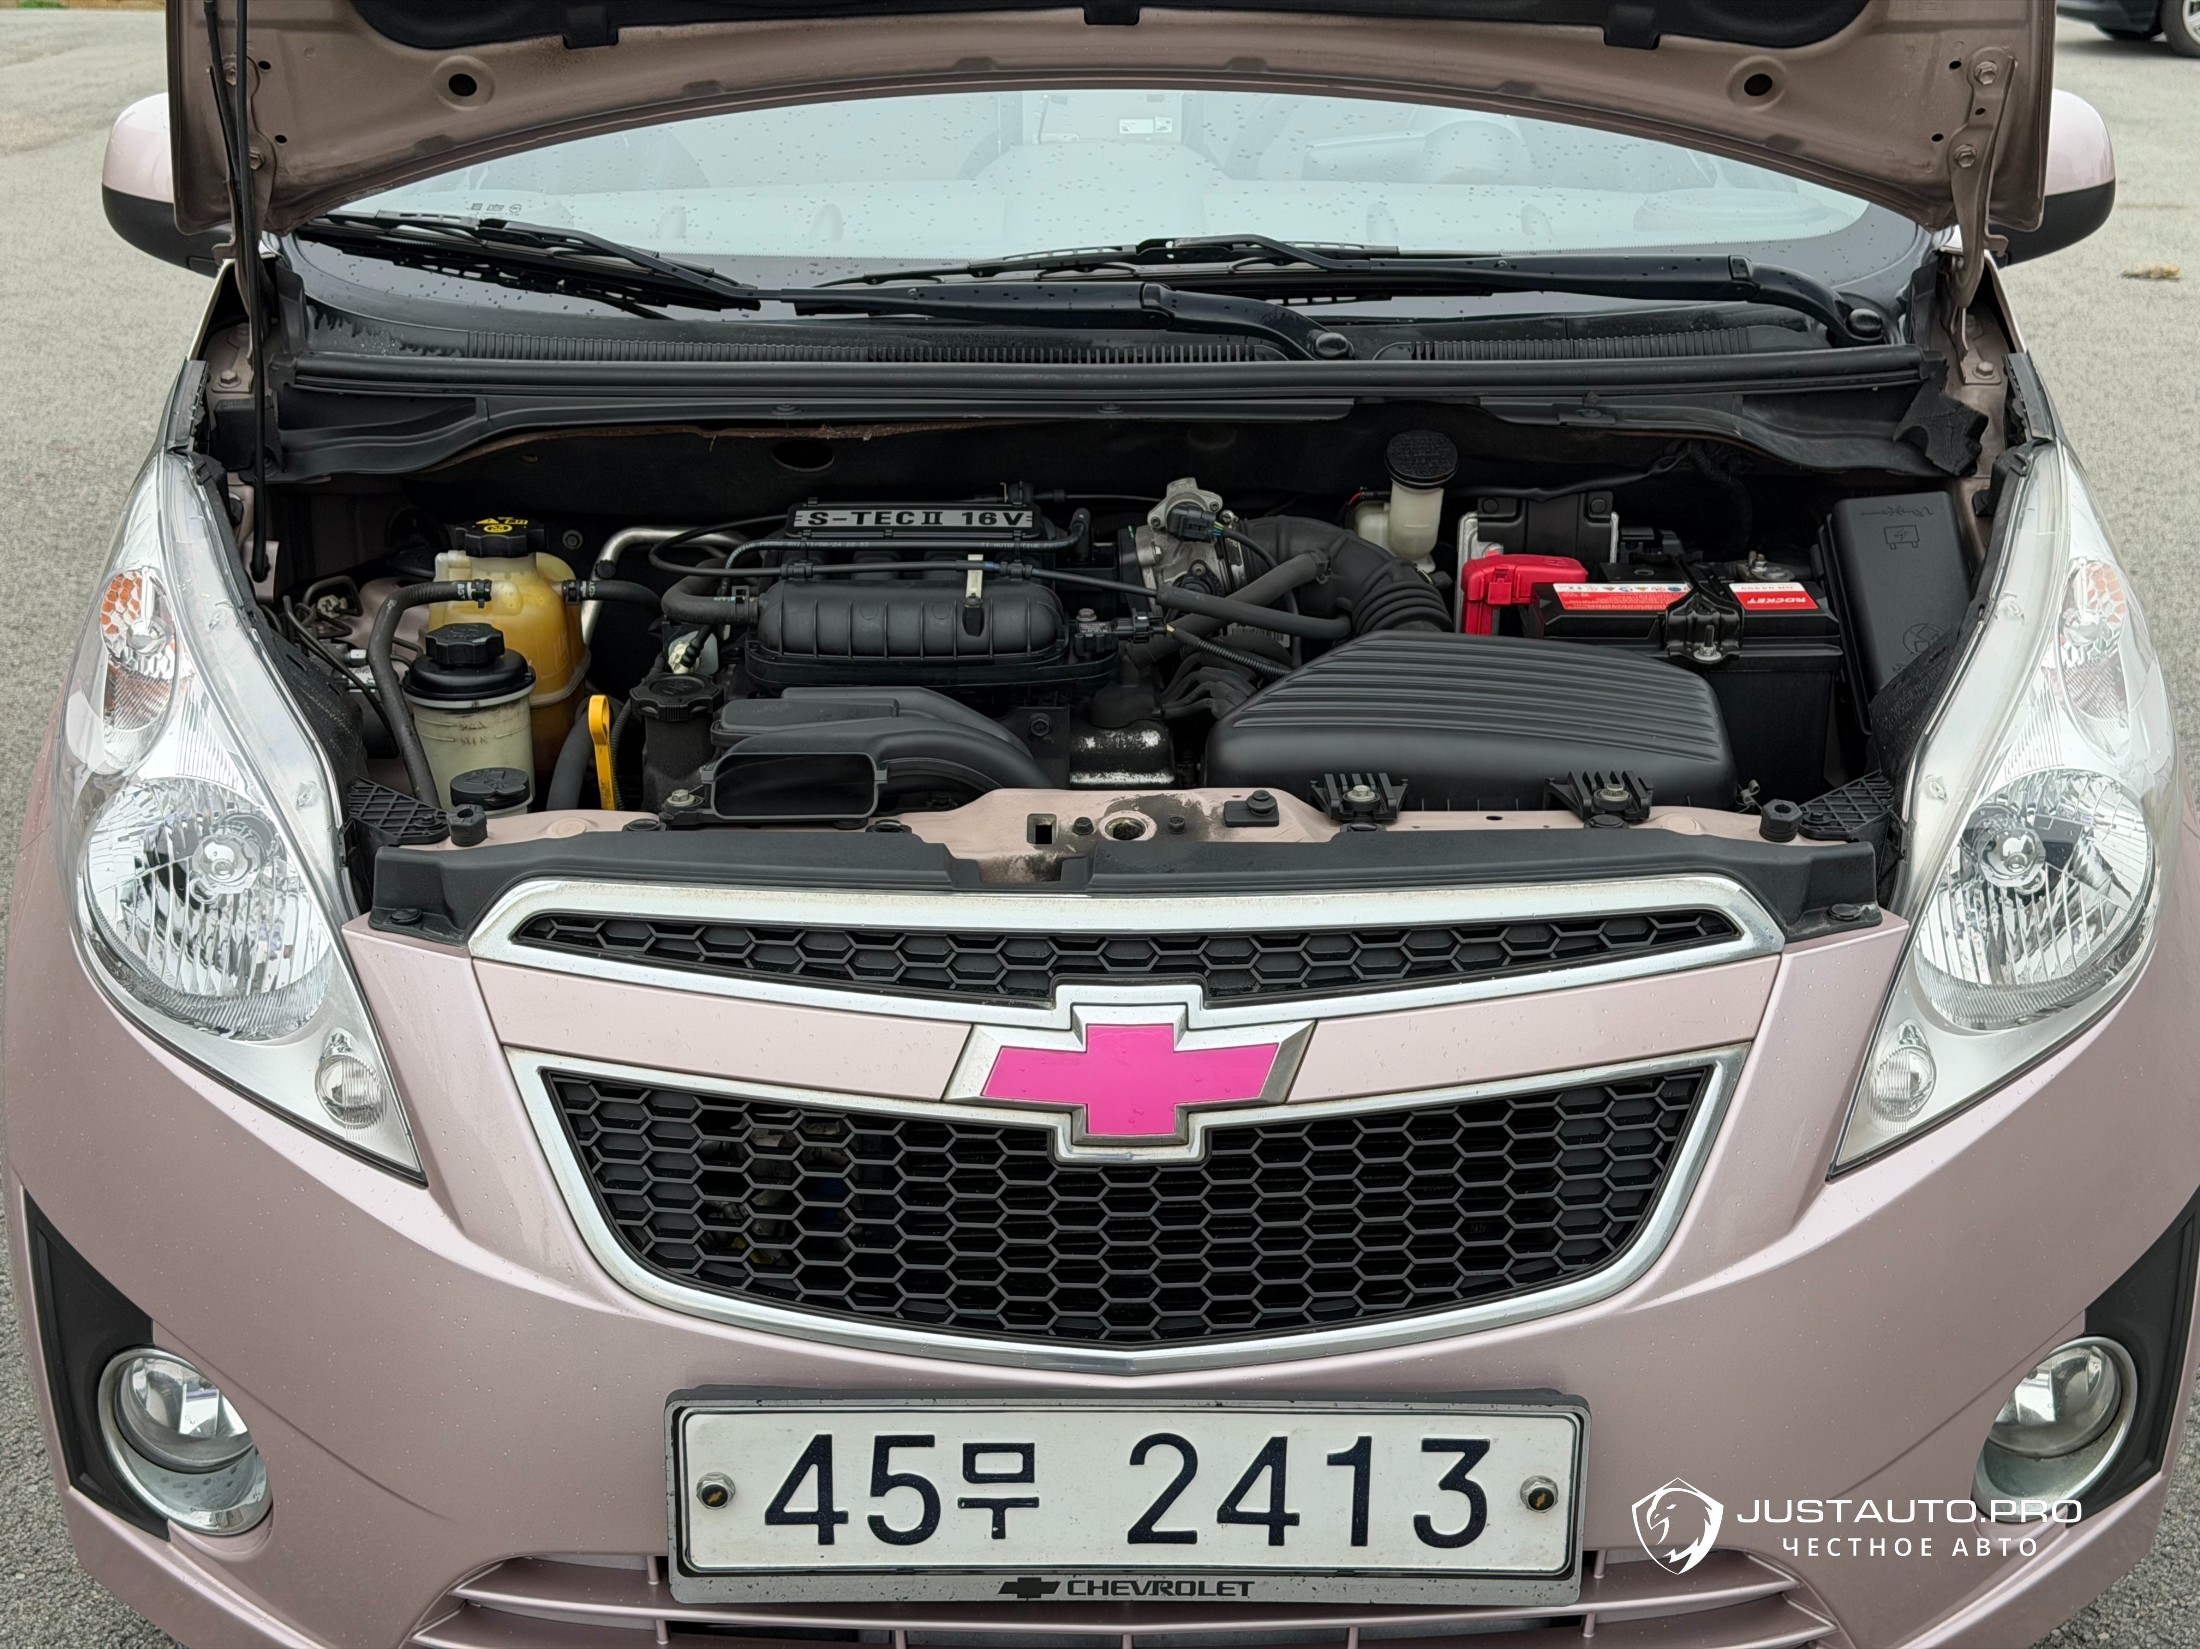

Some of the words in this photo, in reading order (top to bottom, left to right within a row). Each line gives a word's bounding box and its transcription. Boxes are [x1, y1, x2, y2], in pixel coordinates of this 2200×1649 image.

[961, 511, 1027, 526] 16V
[1746, 596, 1807, 604] ROCKET
[764, 1432, 1040, 1547] 45무
[1127, 1431, 1491, 1549] 2413
[1067, 1579, 1255, 1598] CHEVROLET
